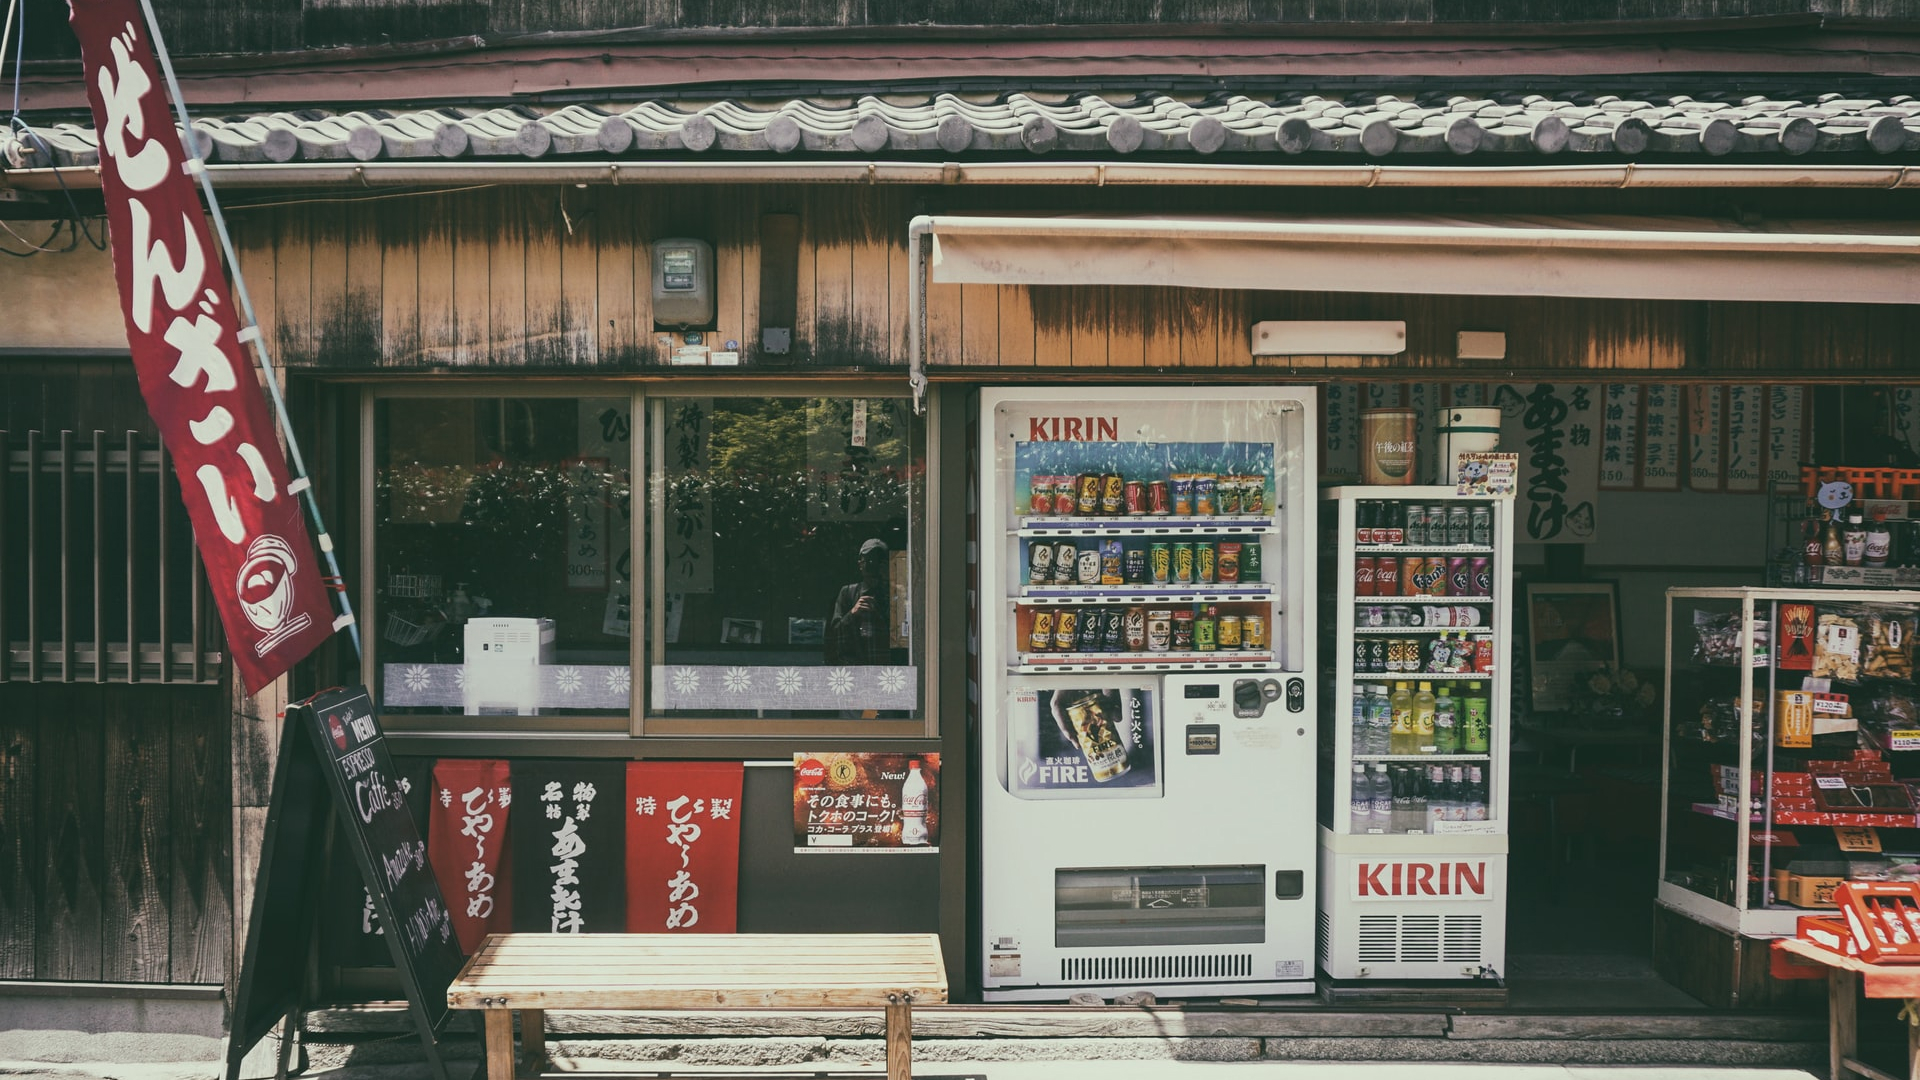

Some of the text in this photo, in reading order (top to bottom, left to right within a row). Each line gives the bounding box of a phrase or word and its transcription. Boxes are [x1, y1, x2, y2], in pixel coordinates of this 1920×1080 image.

[97, 20, 277, 545] ぜんざい
[1569, 385, 1592, 447] 名物
[1730, 386, 1746, 469] チョコチーノ
[1029, 417, 1118, 441] KIRIN
[1523, 384, 1569, 540] あまざけ
[1250, 547, 1259, 567] 生茶
[350, 714, 377, 743] MENU
[1129, 697, 1143, 749] 心に火を。
[1092, 739, 1117, 753] FIRE
[341, 747, 376, 780] ESPRESSO
[800, 767, 824, 777] Coca-Cola
[1045, 756, 1080, 765] 直火珈琲
[881, 771, 906, 780] New!
[1039, 765, 1088, 783] FIRE
[807, 794, 897, 809] その食事にも。
[807, 825, 849, 834] コカ・コーラ
[851, 825, 873, 833] プラス
[1358, 862, 1486, 896] KIRIN
